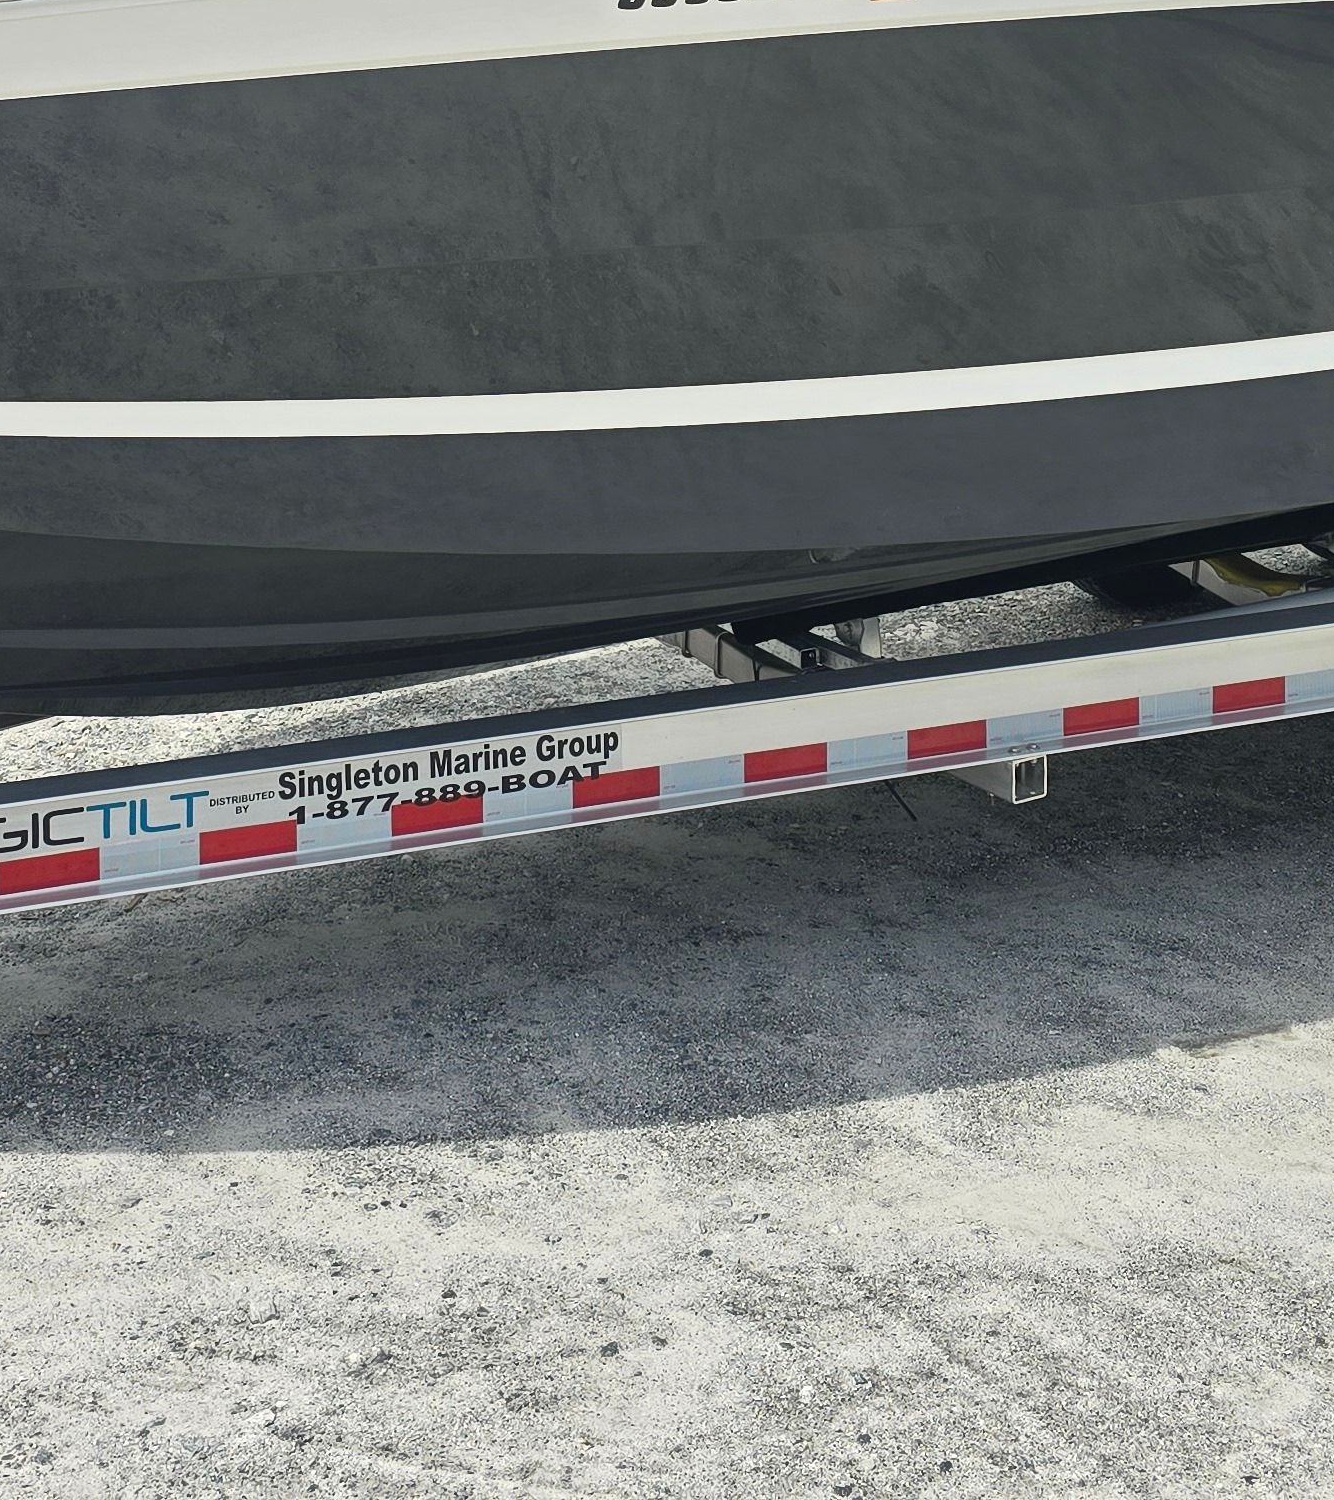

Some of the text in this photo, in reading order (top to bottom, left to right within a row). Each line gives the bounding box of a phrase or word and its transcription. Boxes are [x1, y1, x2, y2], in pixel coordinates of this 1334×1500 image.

[278, 730, 619, 800] Singleton Marine Group
[209, 790, 275, 807] DISTRIBUTED
[235, 804, 250, 815] BY
[288, 761, 607, 825] 1-877-889-BOAT
